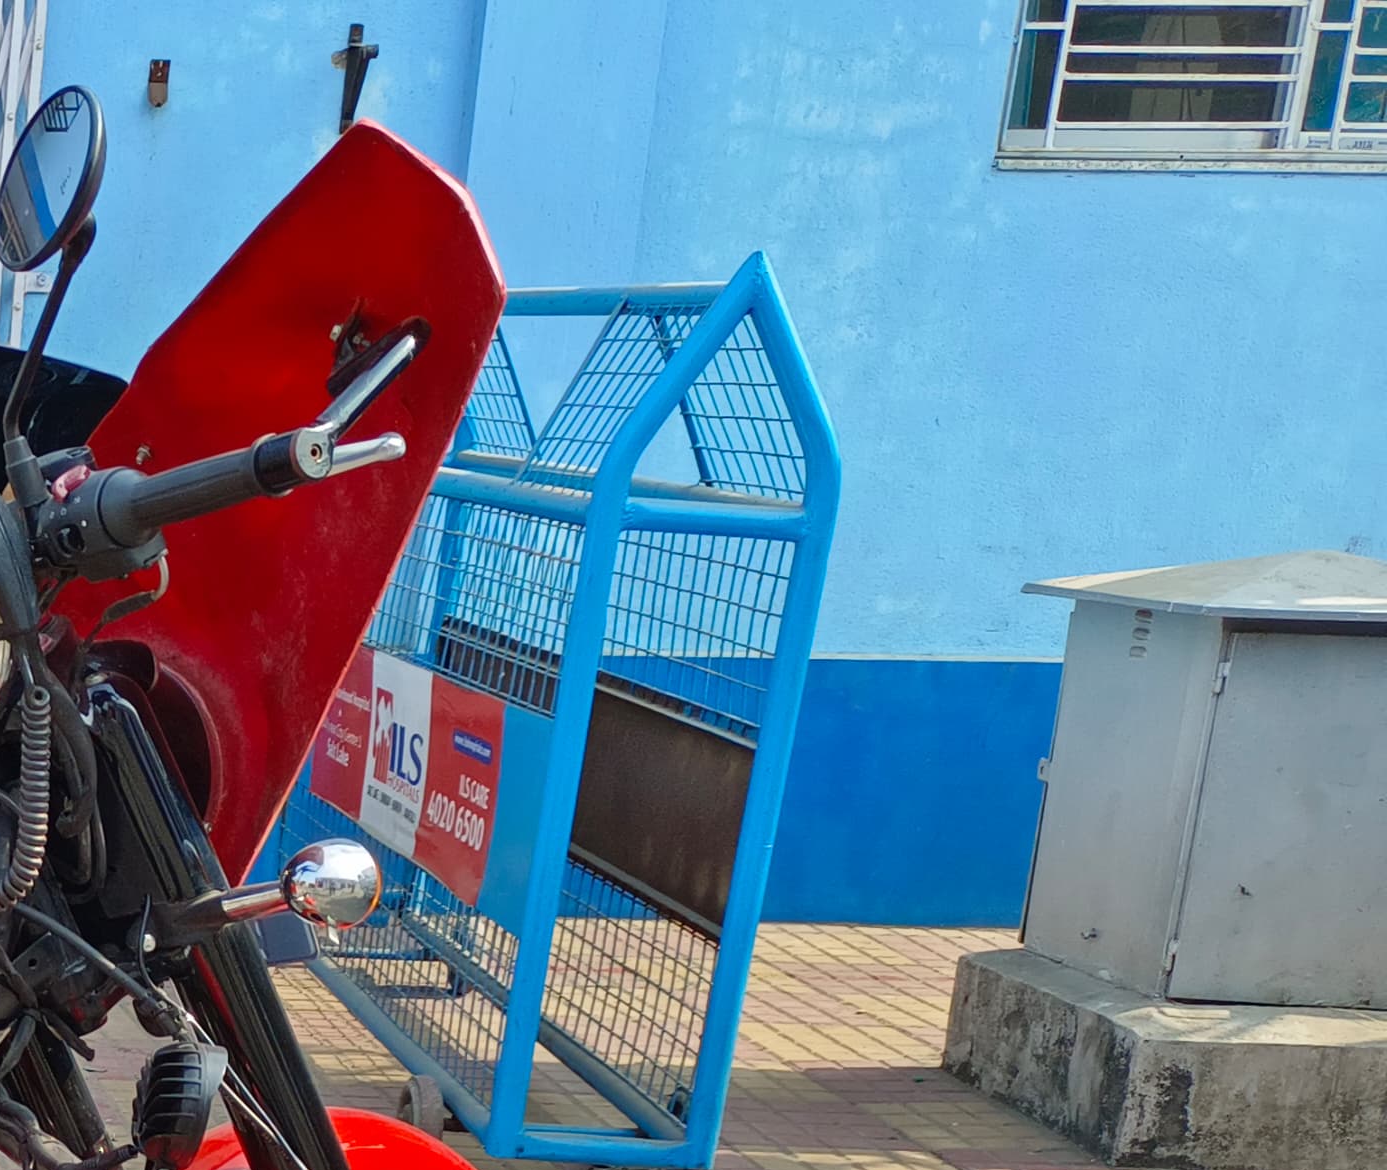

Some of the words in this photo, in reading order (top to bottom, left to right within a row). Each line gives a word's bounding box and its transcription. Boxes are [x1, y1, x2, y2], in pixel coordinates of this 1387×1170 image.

[389, 722, 424, 787] ILS
[459, 774, 471, 799] ILS
[427, 789, 456, 833] 4020
[454, 805, 485, 852] 6500
